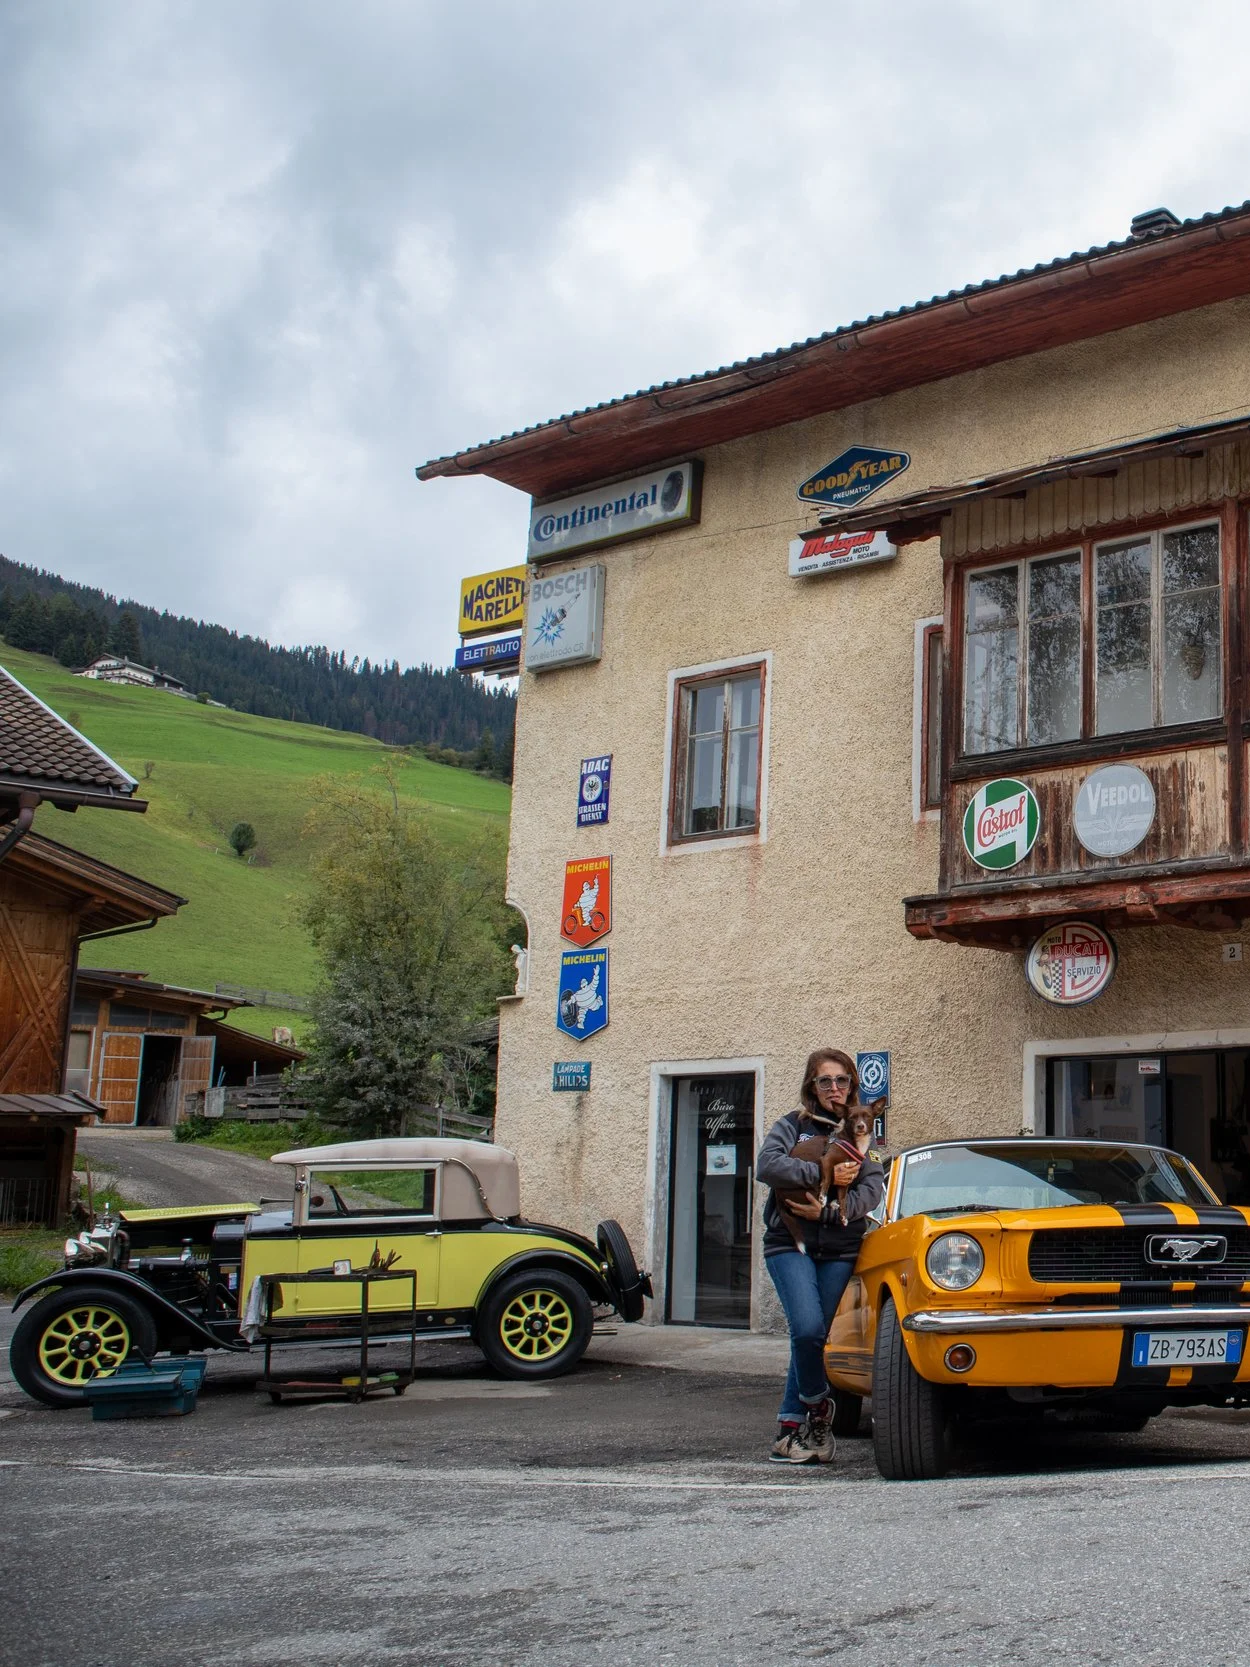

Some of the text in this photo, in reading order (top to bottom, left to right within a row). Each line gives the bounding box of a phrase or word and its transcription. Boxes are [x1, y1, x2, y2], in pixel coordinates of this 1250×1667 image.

[803, 456, 902, 496] GOODYEAR
[832, 484, 871, 500] PNEUMATICI
[533, 484, 657, 542] Continental
[852, 546, 870, 554] MOTO
[821, 556, 853, 568] ASSISTENZA
[531, 572, 588, 602] BOSCH
[463, 641, 520, 661] ELETTRAUTO
[581, 758, 610, 775] ADAC
[1086, 783, 1150, 816] VEEDOL
[578, 803, 607, 815] STRASSEN
[581, 811, 603, 822] DIENST
[977, 795, 1026, 848] Castrol
[566, 860, 609, 874] MICHELIN
[1047, 936, 1061, 944] MOTO
[1054, 942, 1104, 958] DUCATI
[1229, 946, 1236, 958] 2
[563, 953, 605, 966] MICHELIN
[1067, 966, 1101, 978] SERVIZIO
[557, 1064, 585, 1074] LAMPADE
[707, 1097, 735, 1112] Büro
[705, 1113, 736, 1139] Ufficio
